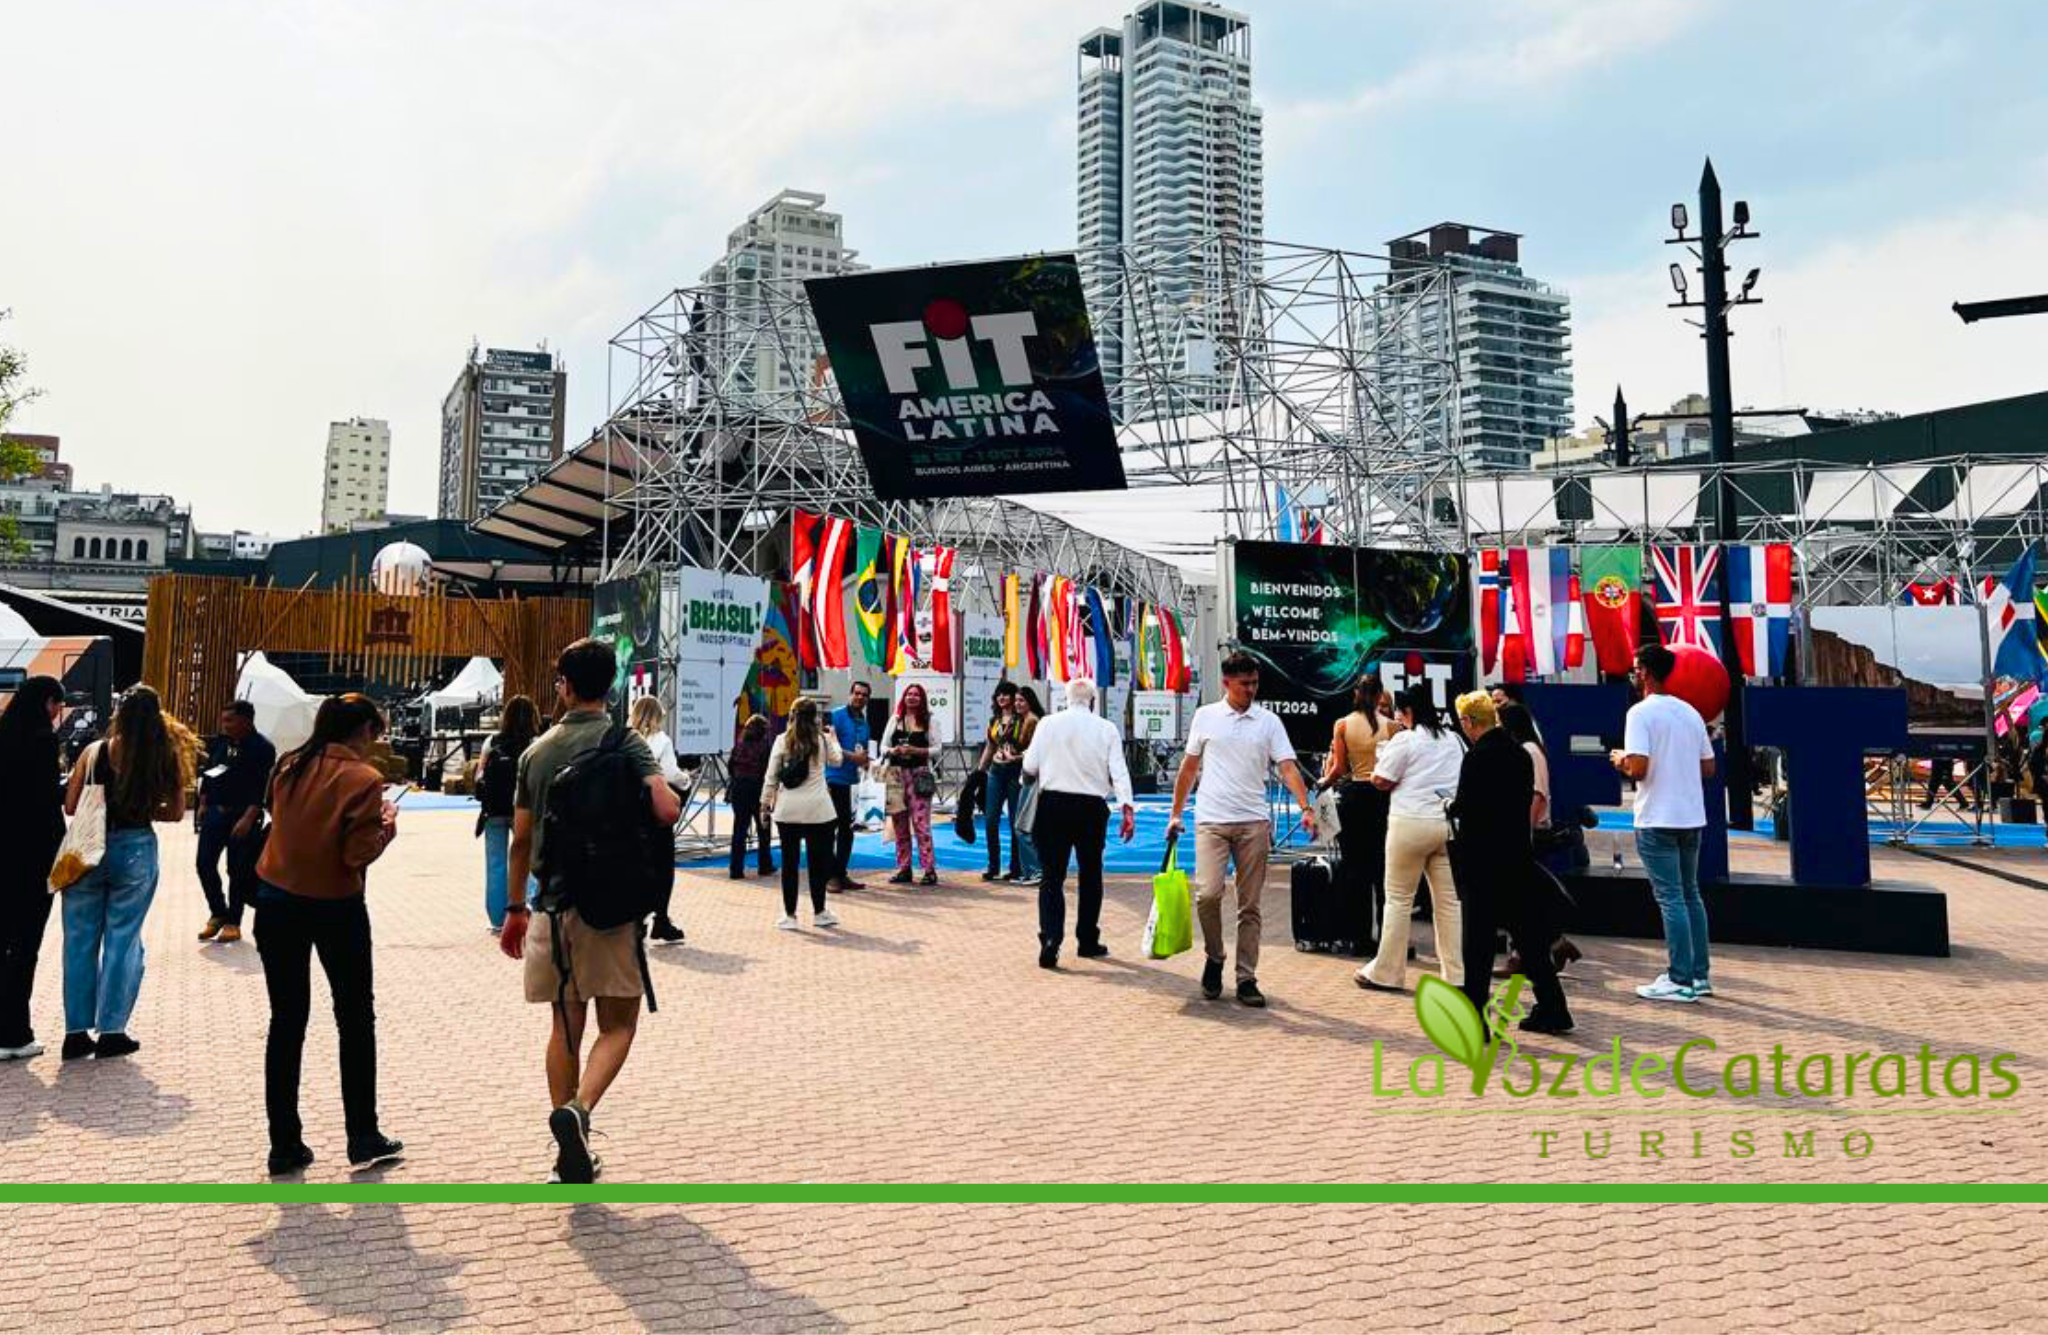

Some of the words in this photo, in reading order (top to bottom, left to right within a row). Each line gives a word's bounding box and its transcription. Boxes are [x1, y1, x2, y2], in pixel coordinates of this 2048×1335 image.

[899, 390, 1056, 420] AMERICA
[903, 413, 1060, 441] LATINA
[915, 466, 962, 477] BUENOS
[963, 463, 996, 474] AIRES
[1005, 459, 1071, 472] ARGENTINA
[1252, 627, 1339, 643] BEM-VINDOS
